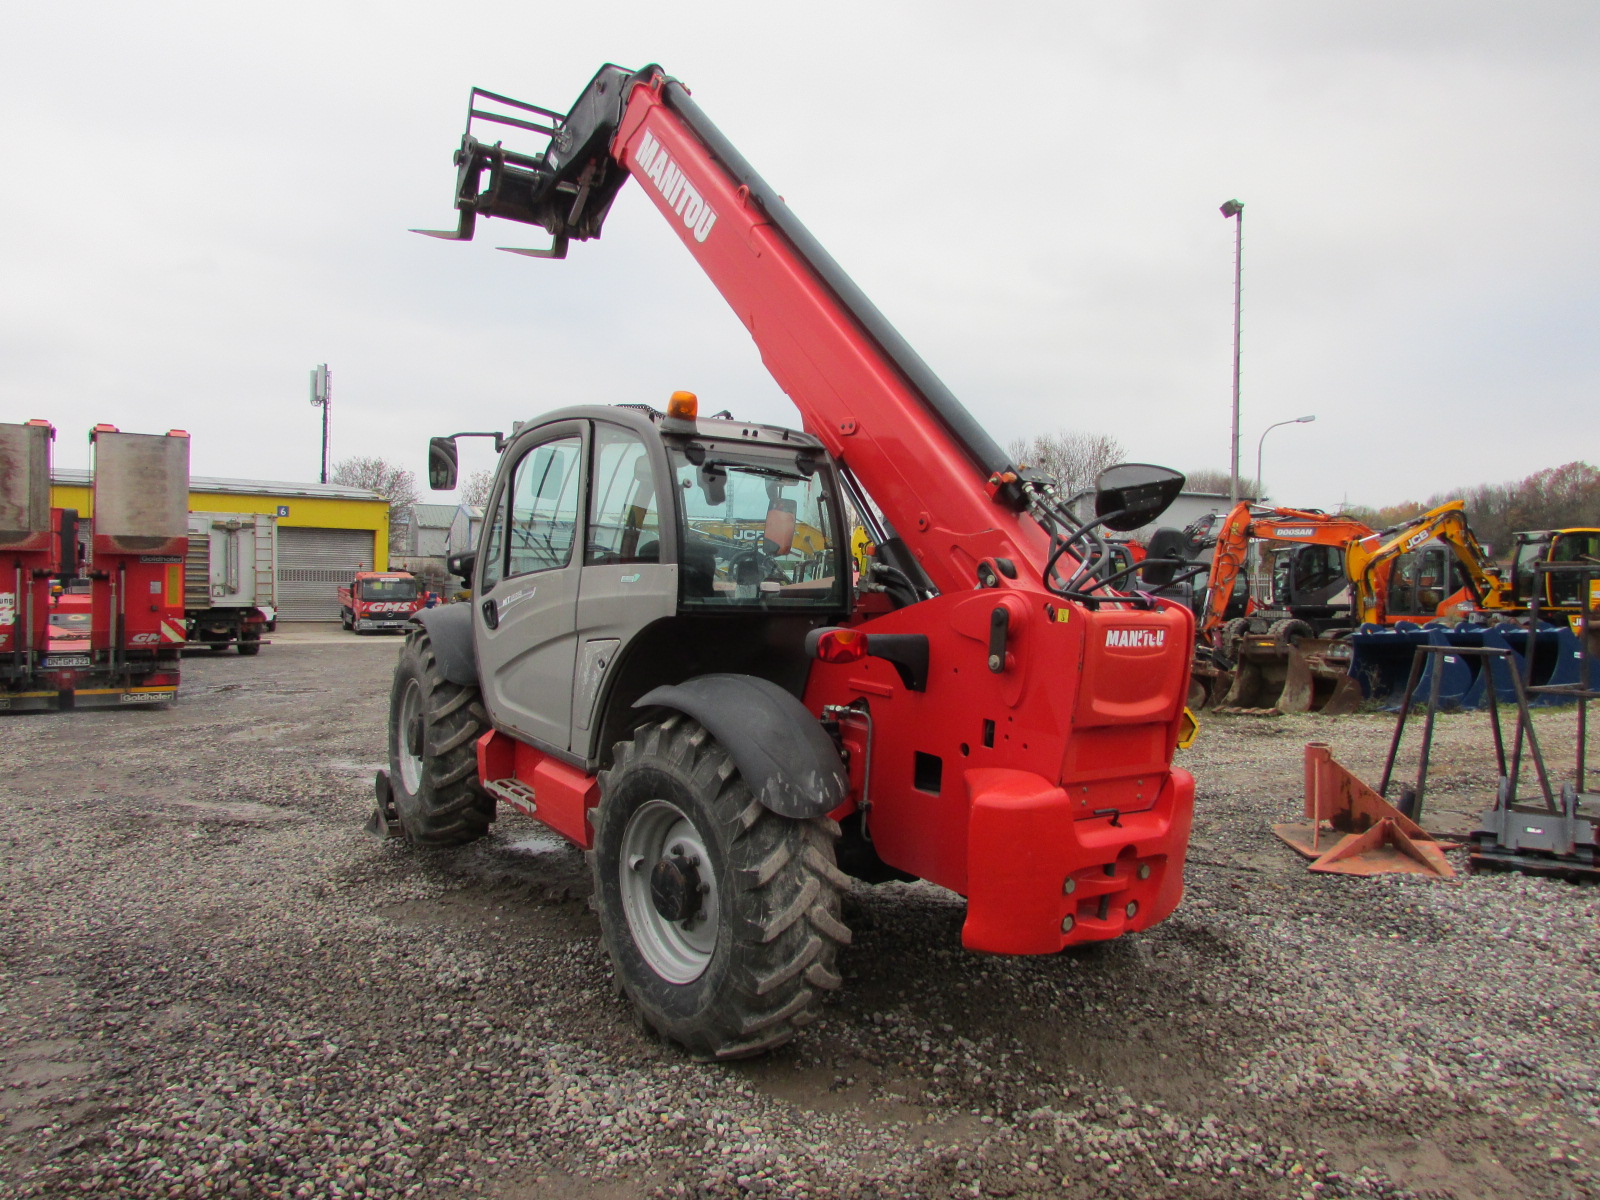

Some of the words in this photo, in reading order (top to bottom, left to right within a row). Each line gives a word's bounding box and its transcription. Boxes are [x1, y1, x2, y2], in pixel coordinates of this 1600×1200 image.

[635, 129, 717, 243] MANITOU
[280, 507, 287, 516] 6
[1276, 528, 1313, 536] DOOSAN
[1406, 529, 1430, 549] JCB
[369, 602, 411, 612] GMS
[123, 693, 172, 701] Goldhofer
